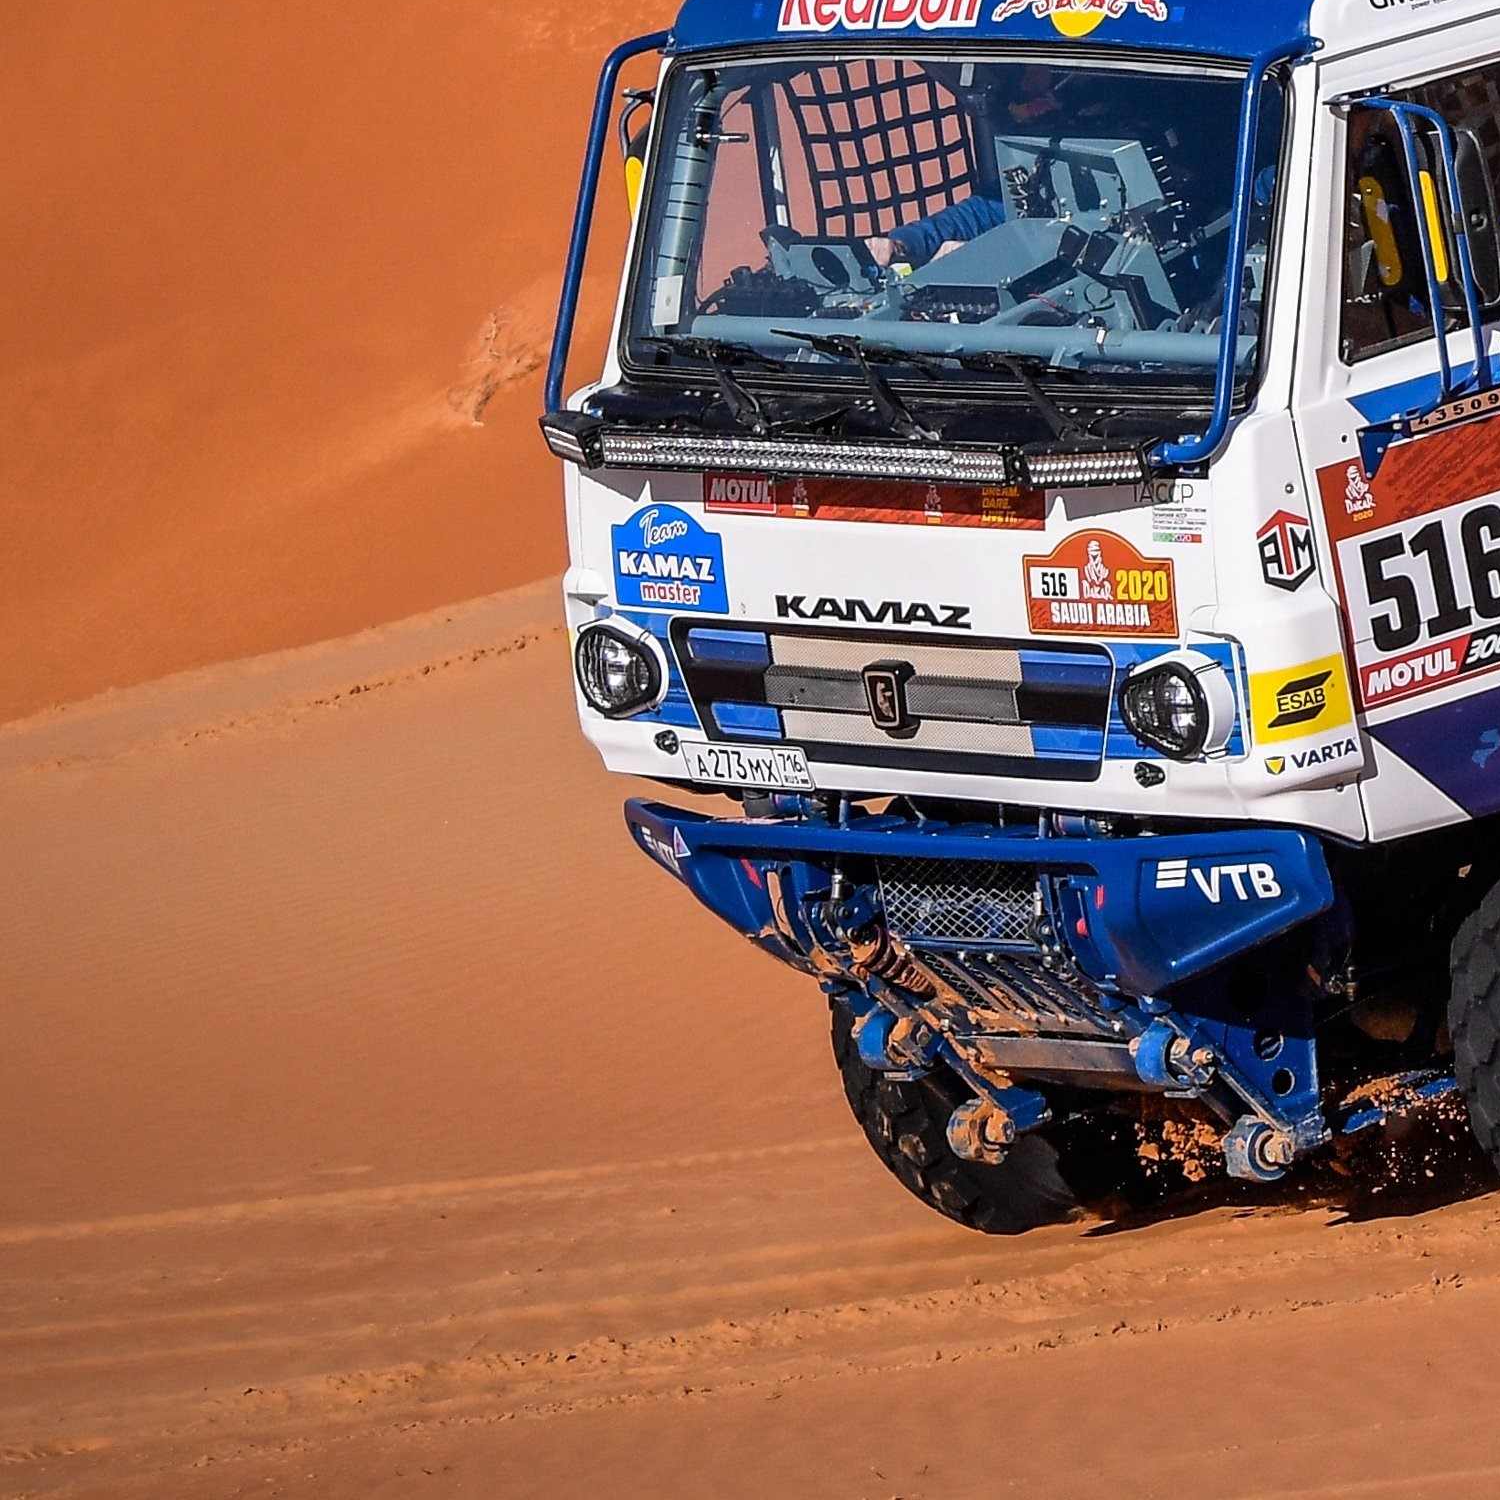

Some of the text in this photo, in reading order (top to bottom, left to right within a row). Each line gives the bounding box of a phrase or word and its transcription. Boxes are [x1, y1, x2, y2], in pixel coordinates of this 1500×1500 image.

[710, 477, 771, 504] MOTUL
[640, 509, 688, 548] Team
[618, 550, 715, 582] KAMAZ
[641, 581, 700, 604] master
[1041, 571, 1068, 597] 516
[1115, 569, 1168, 602] 2020
[776, 595, 973, 630] KAMAZ
[1050, 601, 1151, 627] SAUDI ARABIA
[1367, 648, 1457, 697] MOTUL
[1277, 687, 1325, 713] ESAB
[1291, 738, 1358, 768] VARTA
[784, 775, 800, 785] RUS
[1191, 862, 1282, 903] VTB
